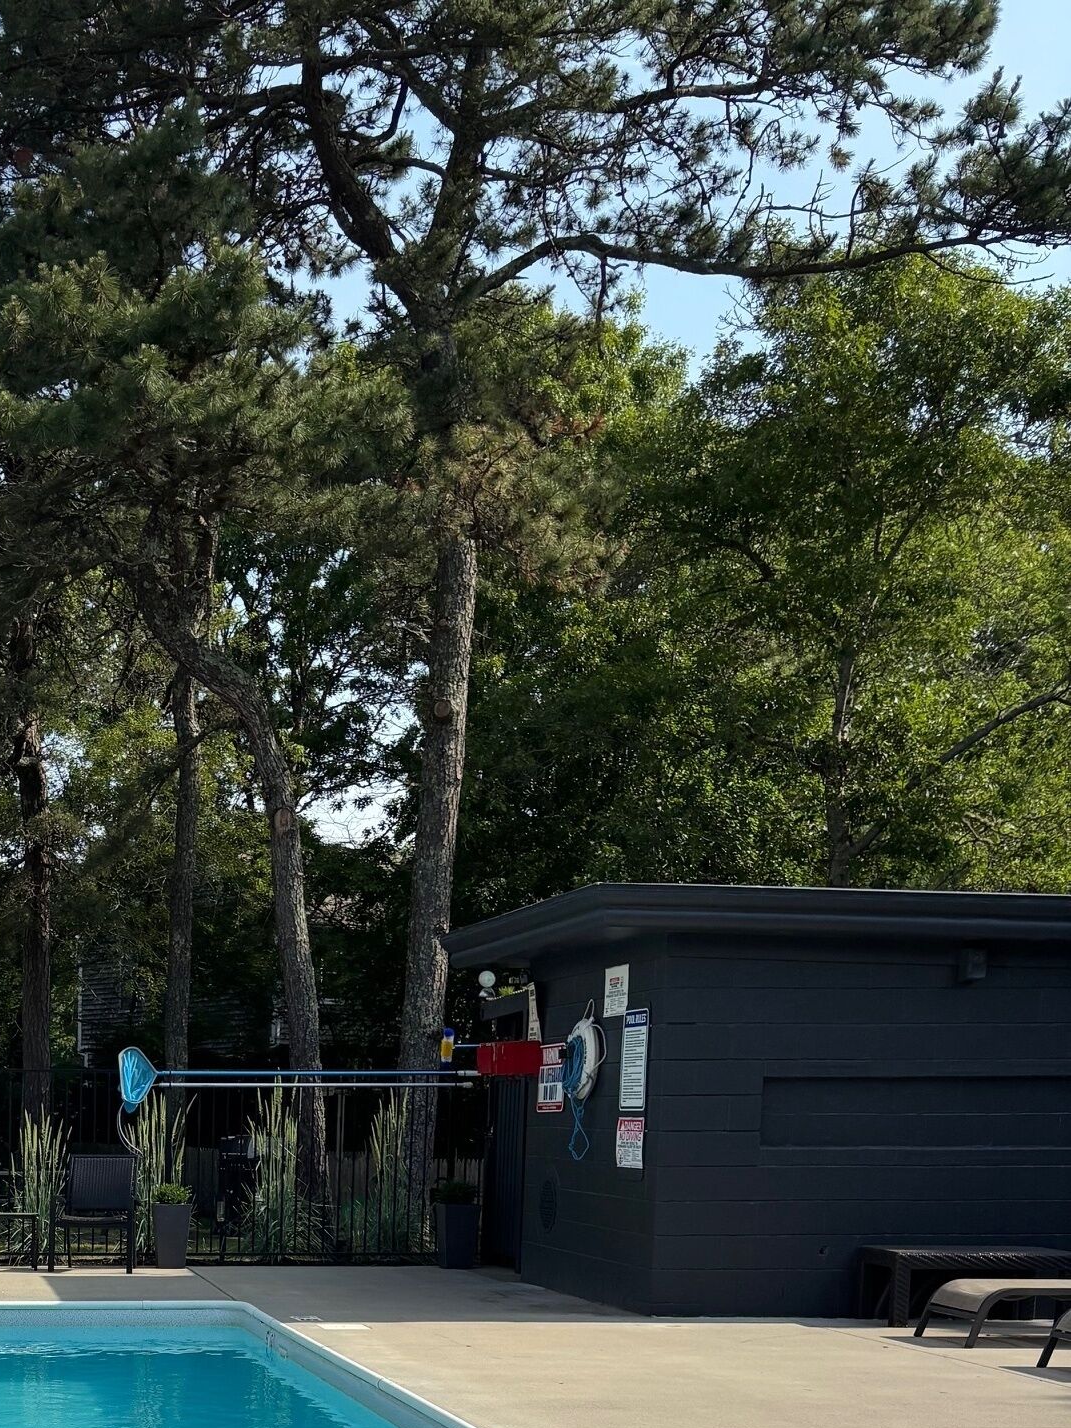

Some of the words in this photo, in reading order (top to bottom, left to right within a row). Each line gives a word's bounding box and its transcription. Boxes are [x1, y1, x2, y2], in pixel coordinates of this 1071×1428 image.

[624, 1120, 642, 1130] DANGER
[619, 1131, 627, 1141] NO
[627, 1131, 642, 1142] DIVING
